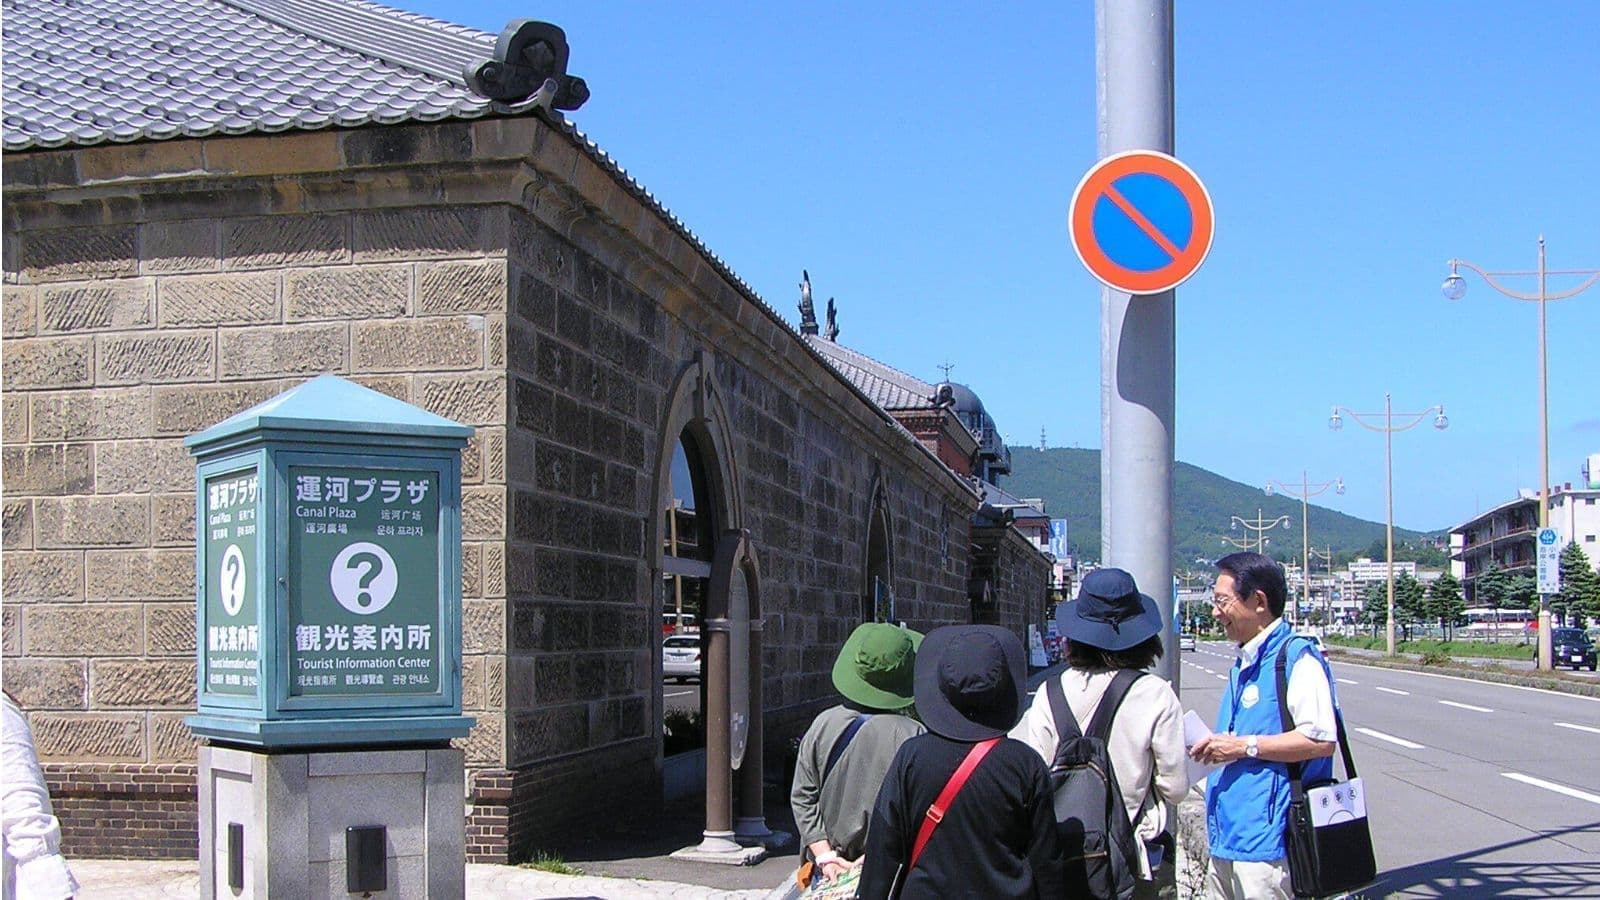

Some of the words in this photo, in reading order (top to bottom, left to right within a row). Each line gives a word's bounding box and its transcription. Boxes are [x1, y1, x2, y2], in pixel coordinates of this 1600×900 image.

[210, 476, 258, 511] 運河プラザ
[295, 475, 429, 505] 運河プラザ
[295, 506, 326, 518] Canal
[328, 506, 357, 519] Plaza
[295, 623, 432, 652] 観光案内所
[297, 657, 334, 670] Tourist
[335, 656, 396, 669] Information
[397, 656, 432, 669] Center
